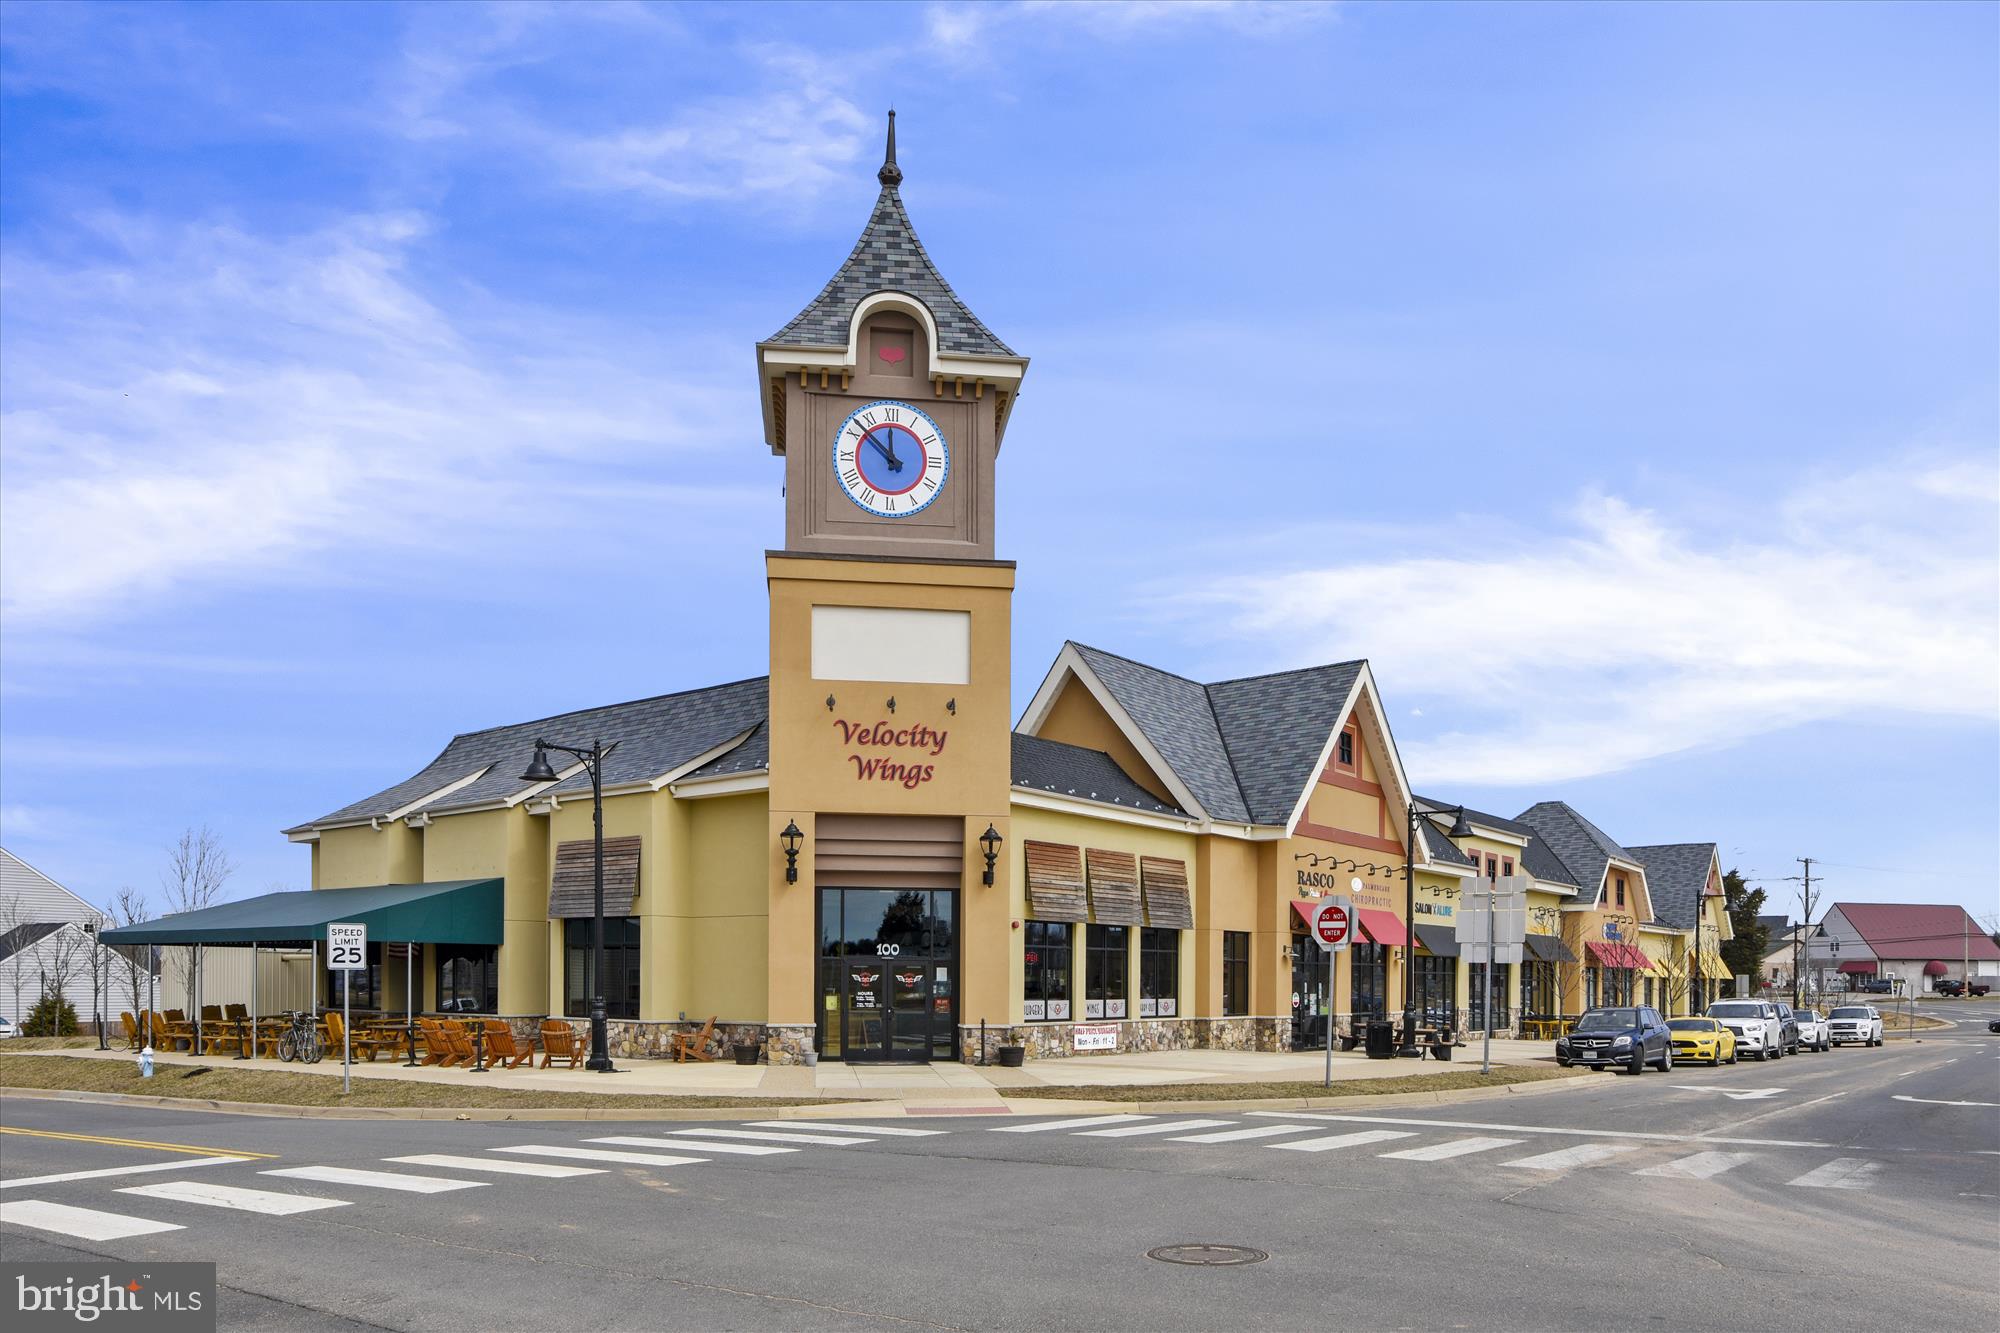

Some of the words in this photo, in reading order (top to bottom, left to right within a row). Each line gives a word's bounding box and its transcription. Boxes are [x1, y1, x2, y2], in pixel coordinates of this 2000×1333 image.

[863, 412, 877, 427] XI
[885, 408, 899, 422] XII
[910, 416, 918, 428] I
[846, 428, 860, 440] X
[923, 434, 936, 445] II
[840, 450, 854, 462] IX
[929, 457, 942, 468] III
[843, 469, 860, 490] VIII
[860, 488, 874, 506] VII
[910, 494, 918, 506] V
[886, 496, 896, 511] VI
[834, 719, 948, 756] Velocity
[848, 754, 935, 789] Wings
[1297, 870, 1334, 888] RASCO
[1352, 894, 1392, 908] CHIROPRACTIC
[1414, 902, 1432, 914] SALON
[332, 928, 362, 936] SPEED
[334, 938, 358, 946] LIMIT
[332, 948, 362, 964] 25
[876, 944, 900, 956] 100
[1078, 1038, 1088, 1046] Mon
